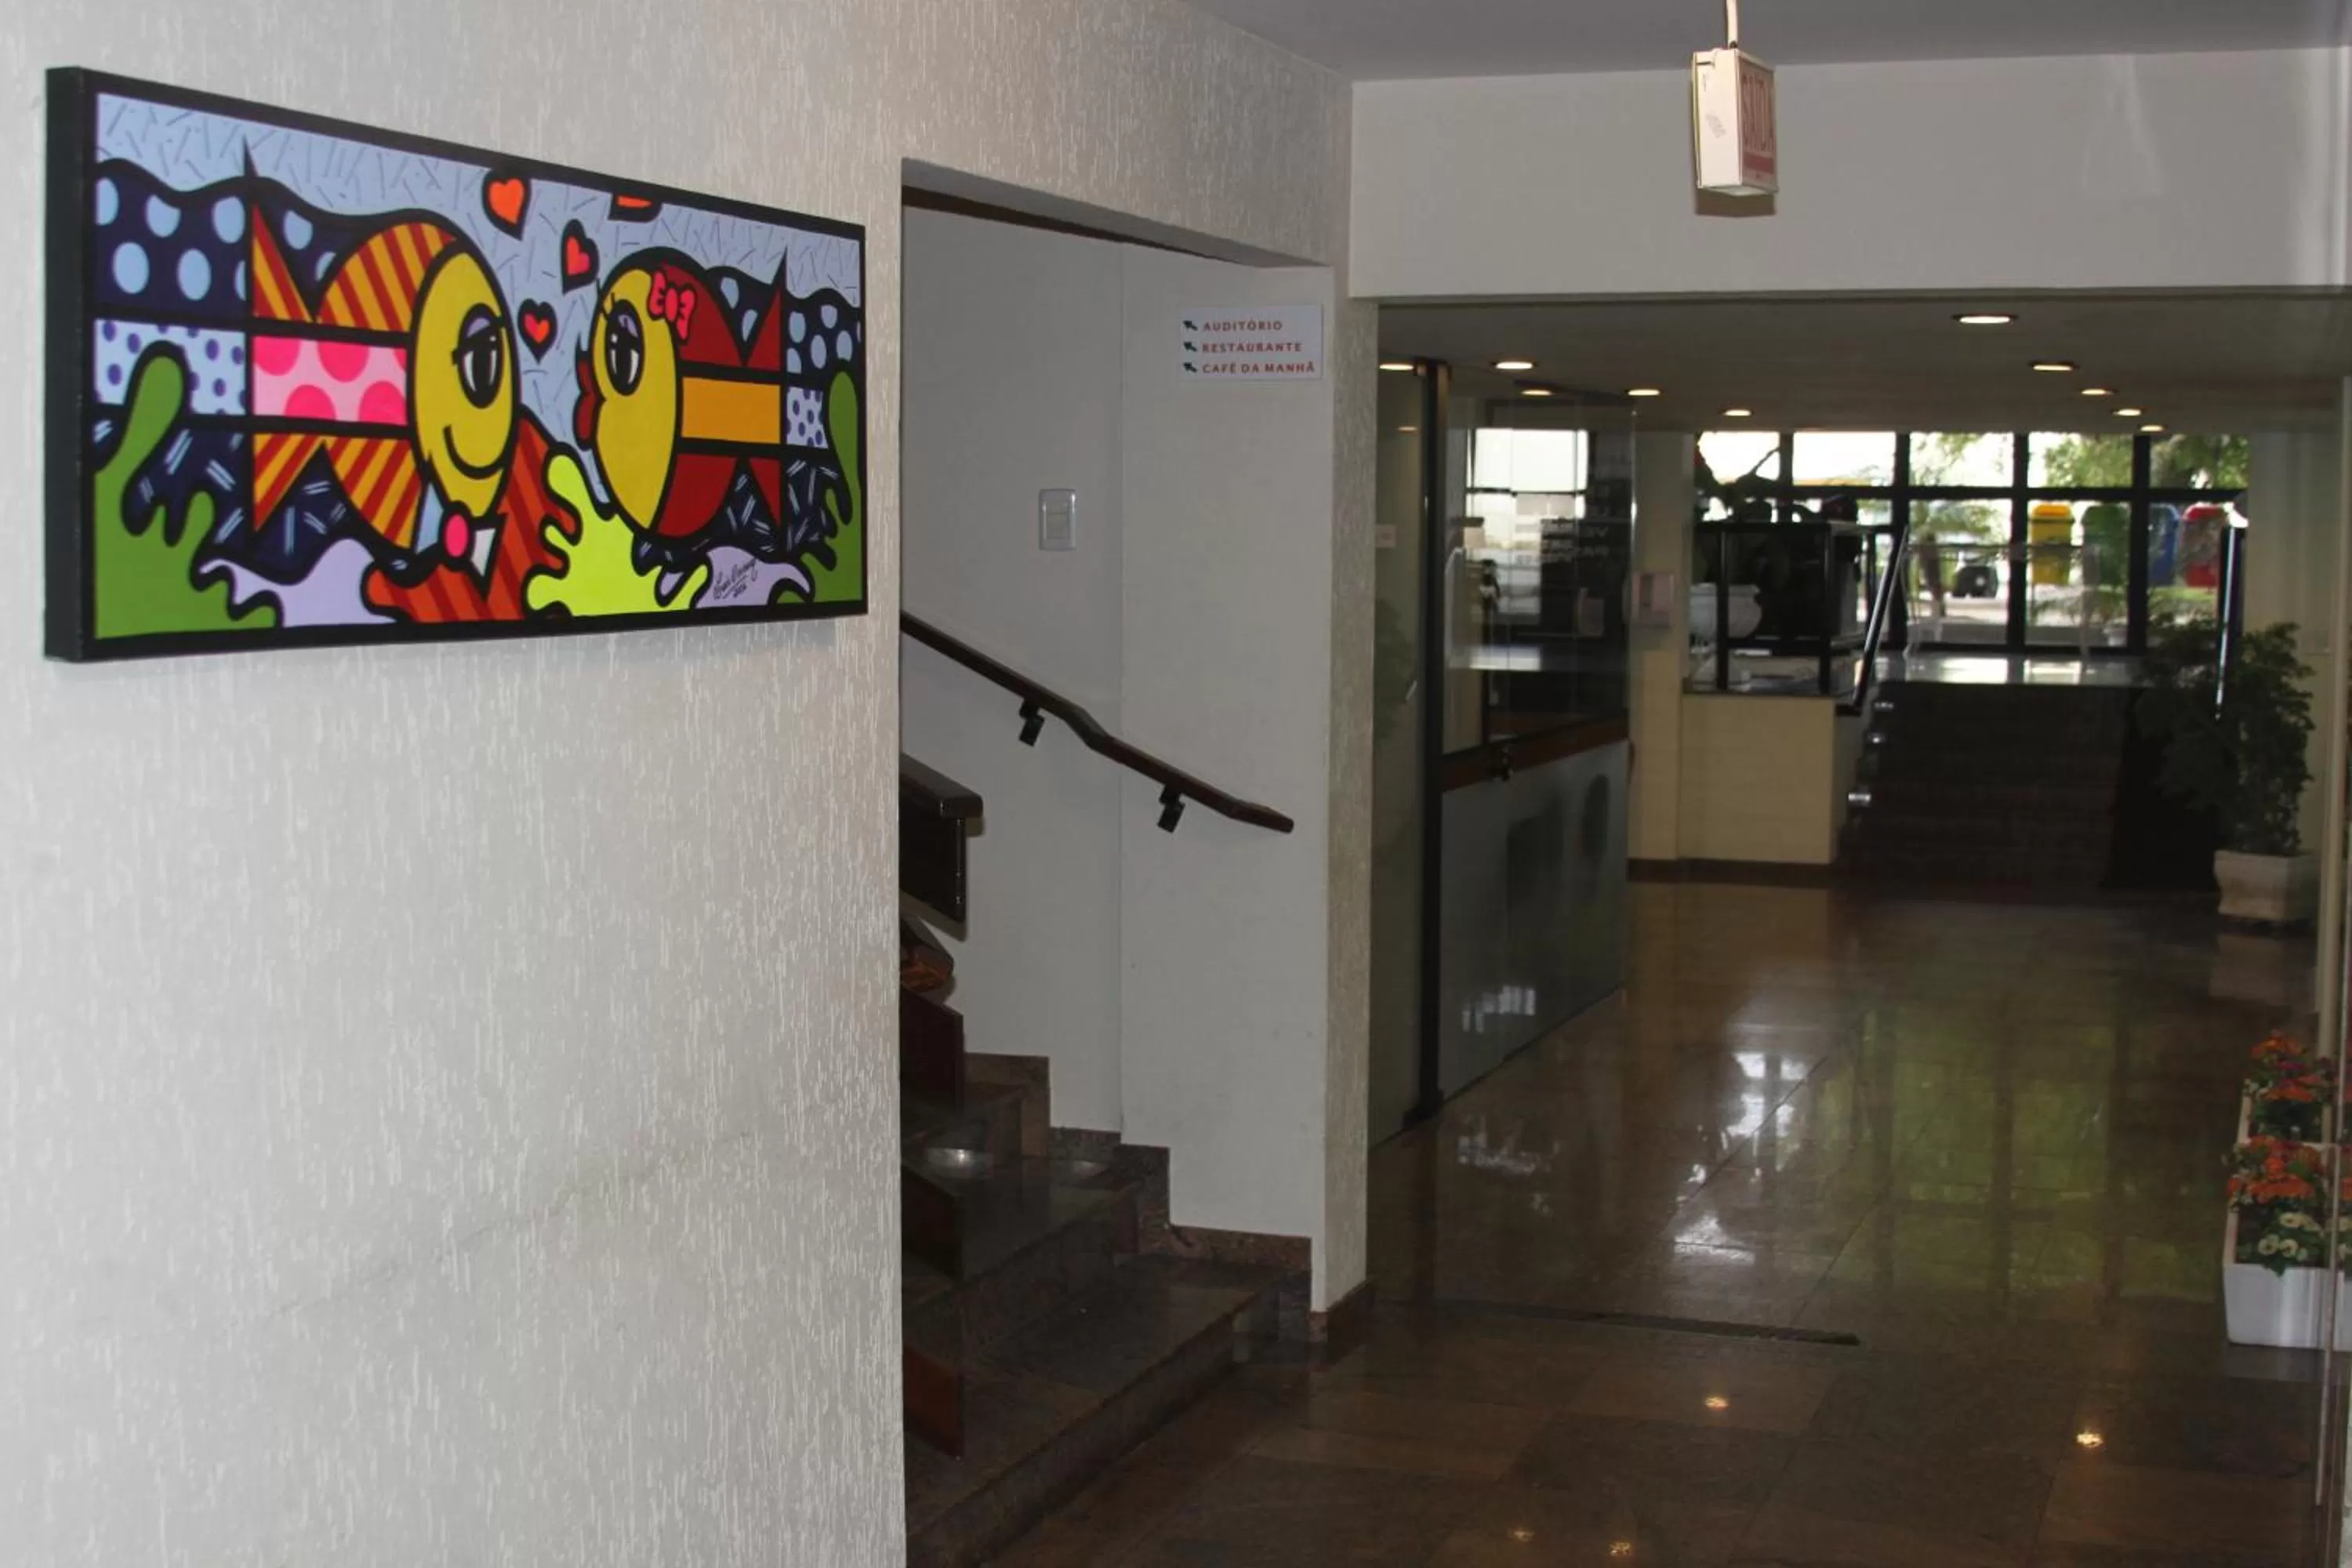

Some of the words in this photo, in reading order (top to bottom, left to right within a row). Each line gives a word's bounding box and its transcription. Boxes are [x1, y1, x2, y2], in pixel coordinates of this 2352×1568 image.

[1203, 319, 1283, 332] AUDITÓRIO
[1202, 342, 1302, 353] RESTAURANTE
[1202, 362, 1236, 373] CAFÉ
[1241, 363, 1259, 372] DA
[1265, 361, 1316, 372] MANHÃ
